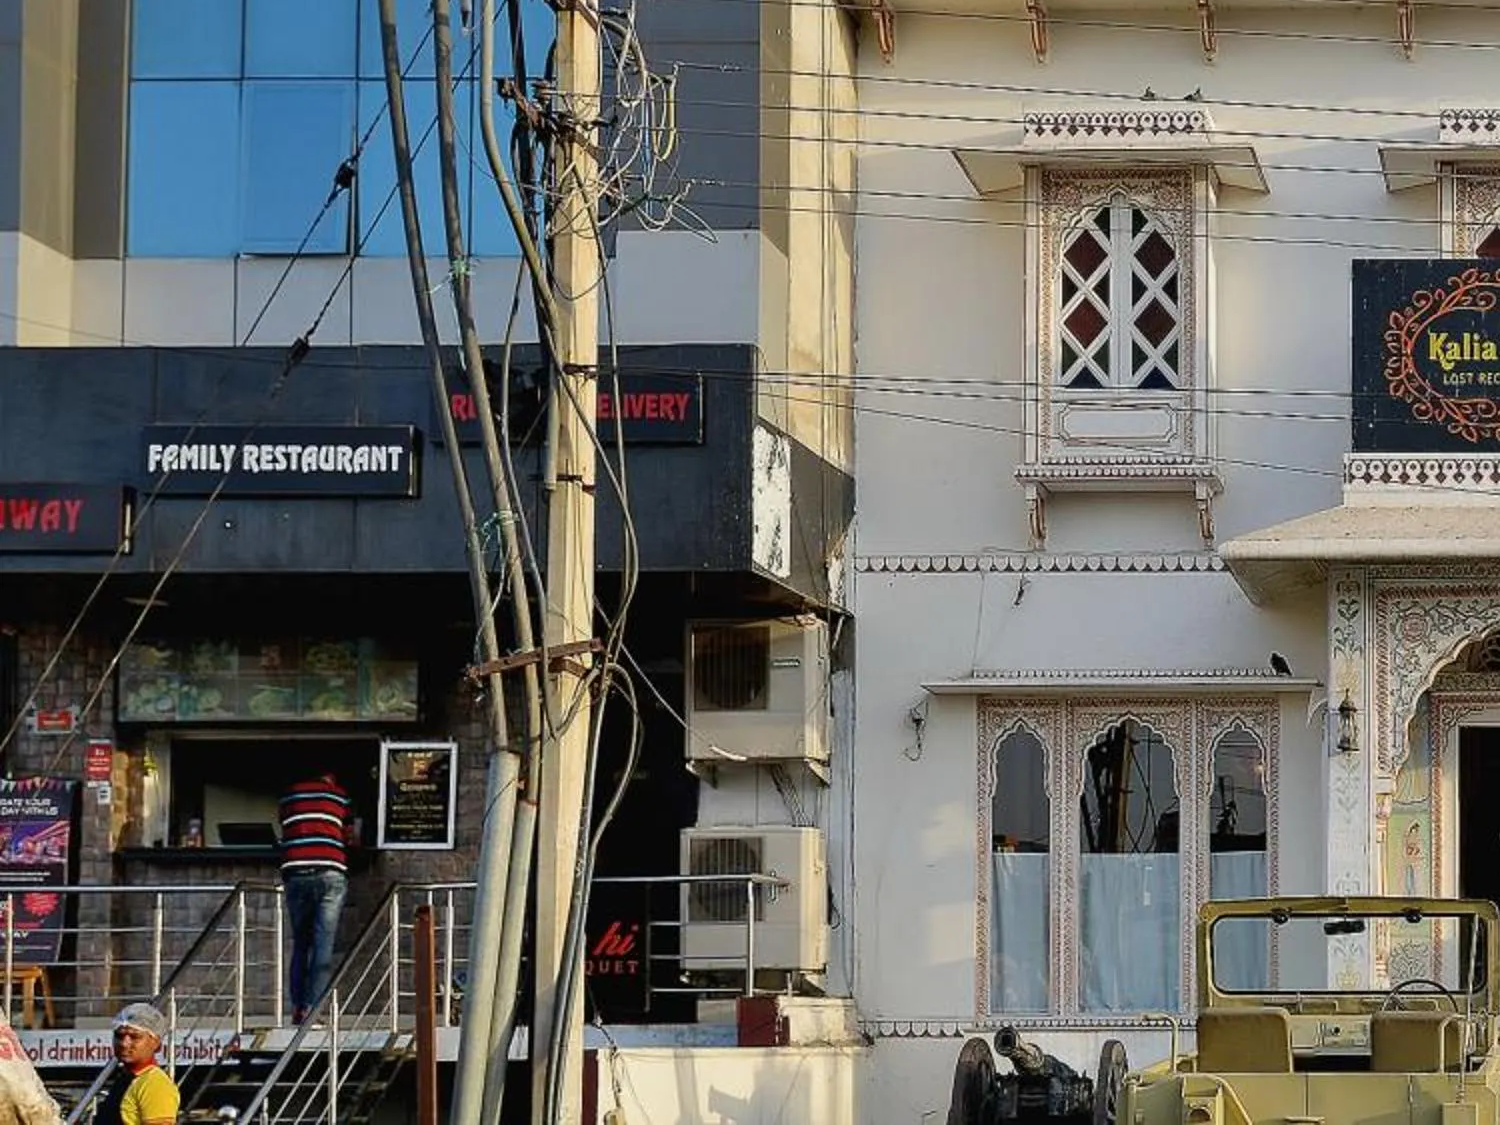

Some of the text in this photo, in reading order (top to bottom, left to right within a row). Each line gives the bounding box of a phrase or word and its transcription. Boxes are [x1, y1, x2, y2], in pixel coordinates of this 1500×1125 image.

[1428, 331, 1498, 370] Kalia
[1443, 372, 1473, 386] LOST
[148, 443, 404, 474] FAMILY RESTAURANT
[0, 498, 84, 536] WAY
[47, 1038, 113, 1062] drinkin
